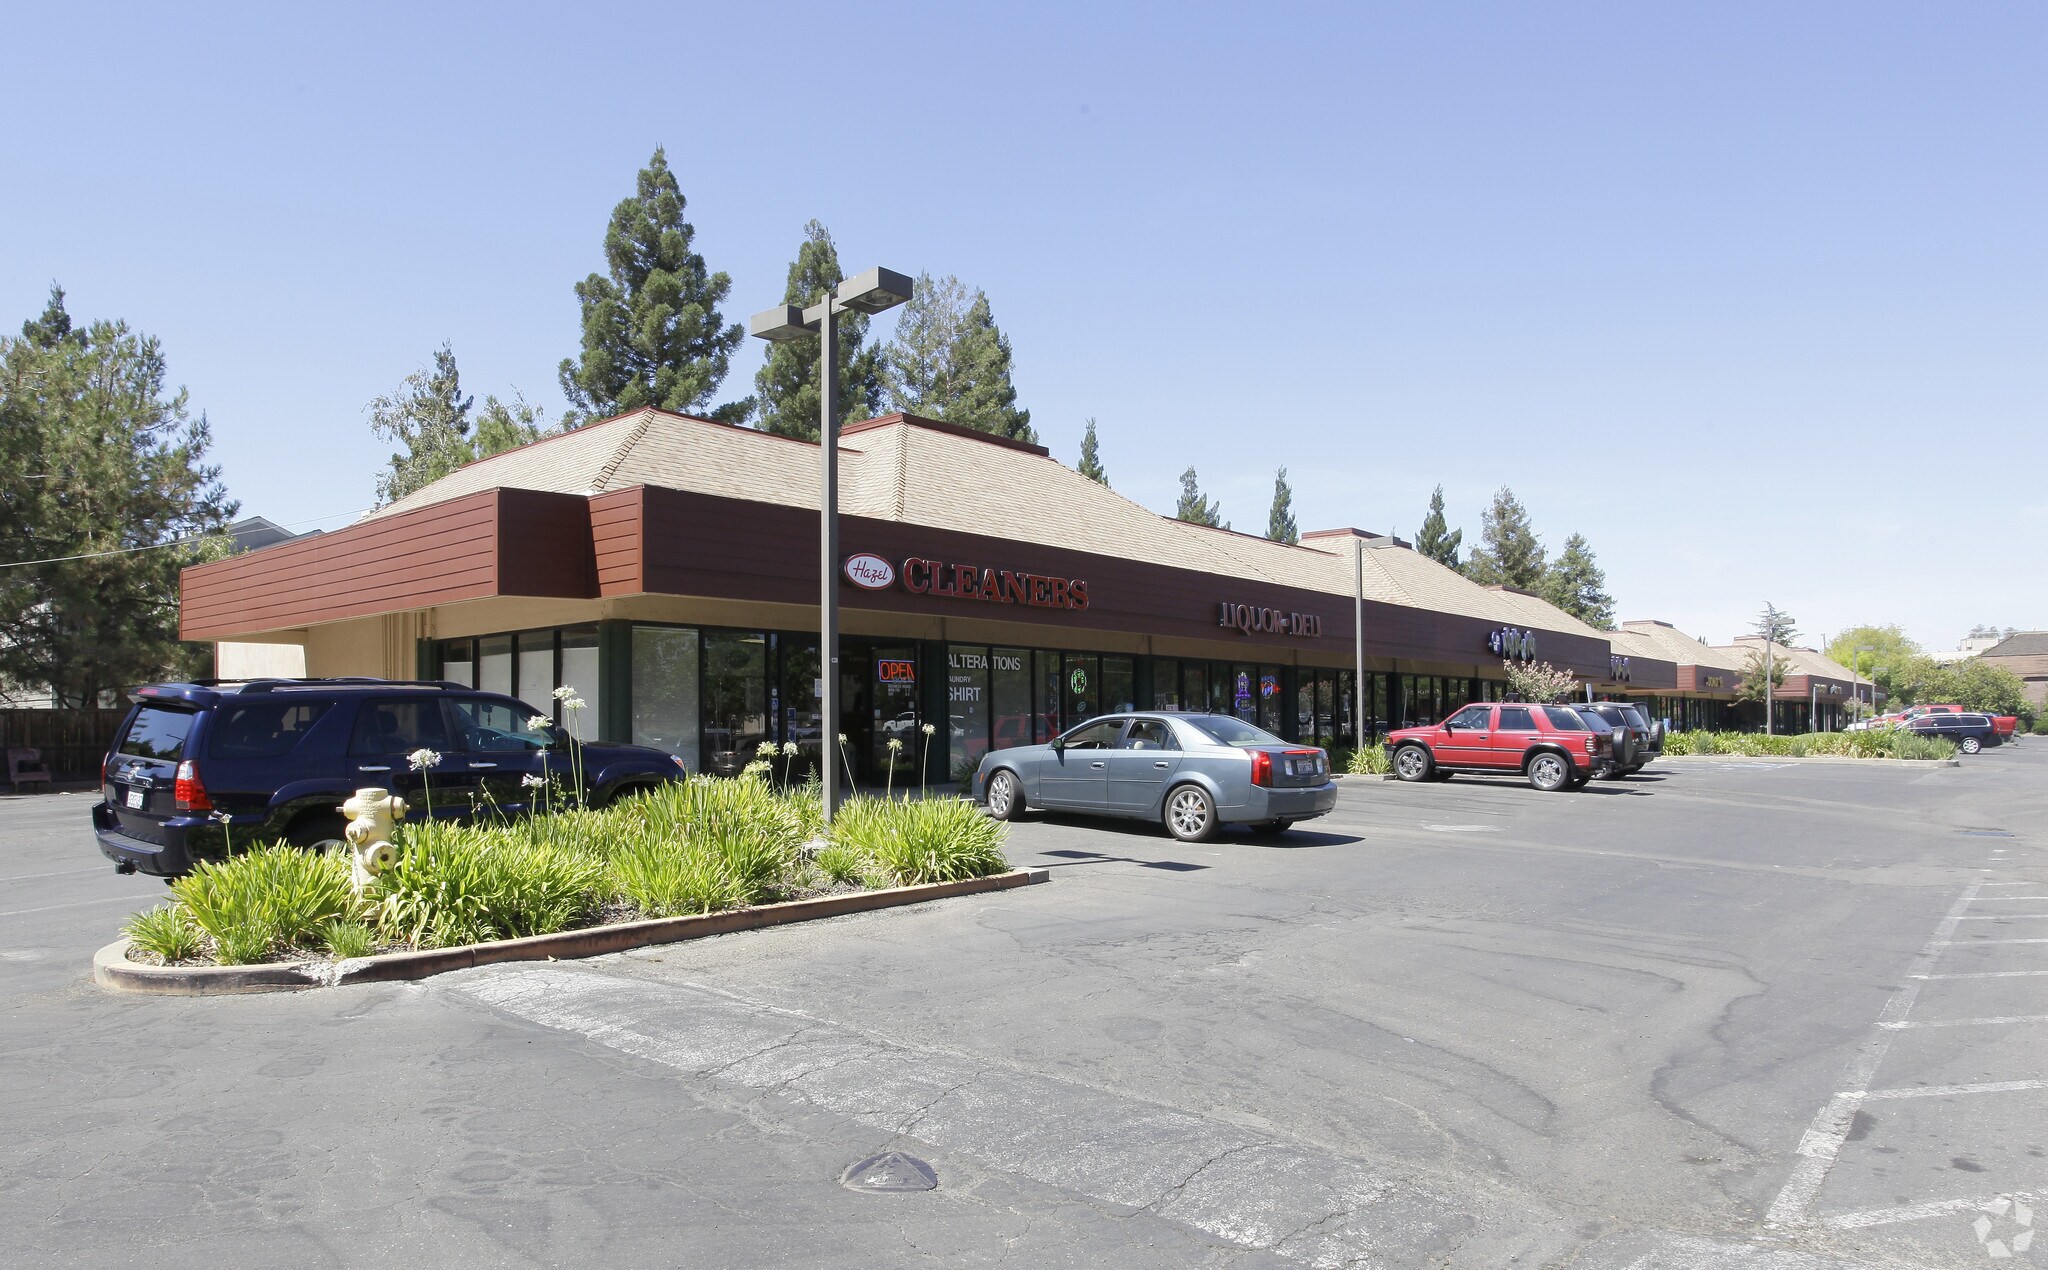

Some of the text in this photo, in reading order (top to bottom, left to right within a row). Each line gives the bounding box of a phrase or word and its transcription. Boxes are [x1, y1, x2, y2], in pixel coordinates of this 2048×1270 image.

[853, 560, 887, 583] Hazel
[903, 557, 1089, 610] CLEANERS
[1222, 602, 1322, 638] LIQUOR DELI
[881, 662, 915, 680] OPEN
[949, 675, 972, 683] AUNDRY
